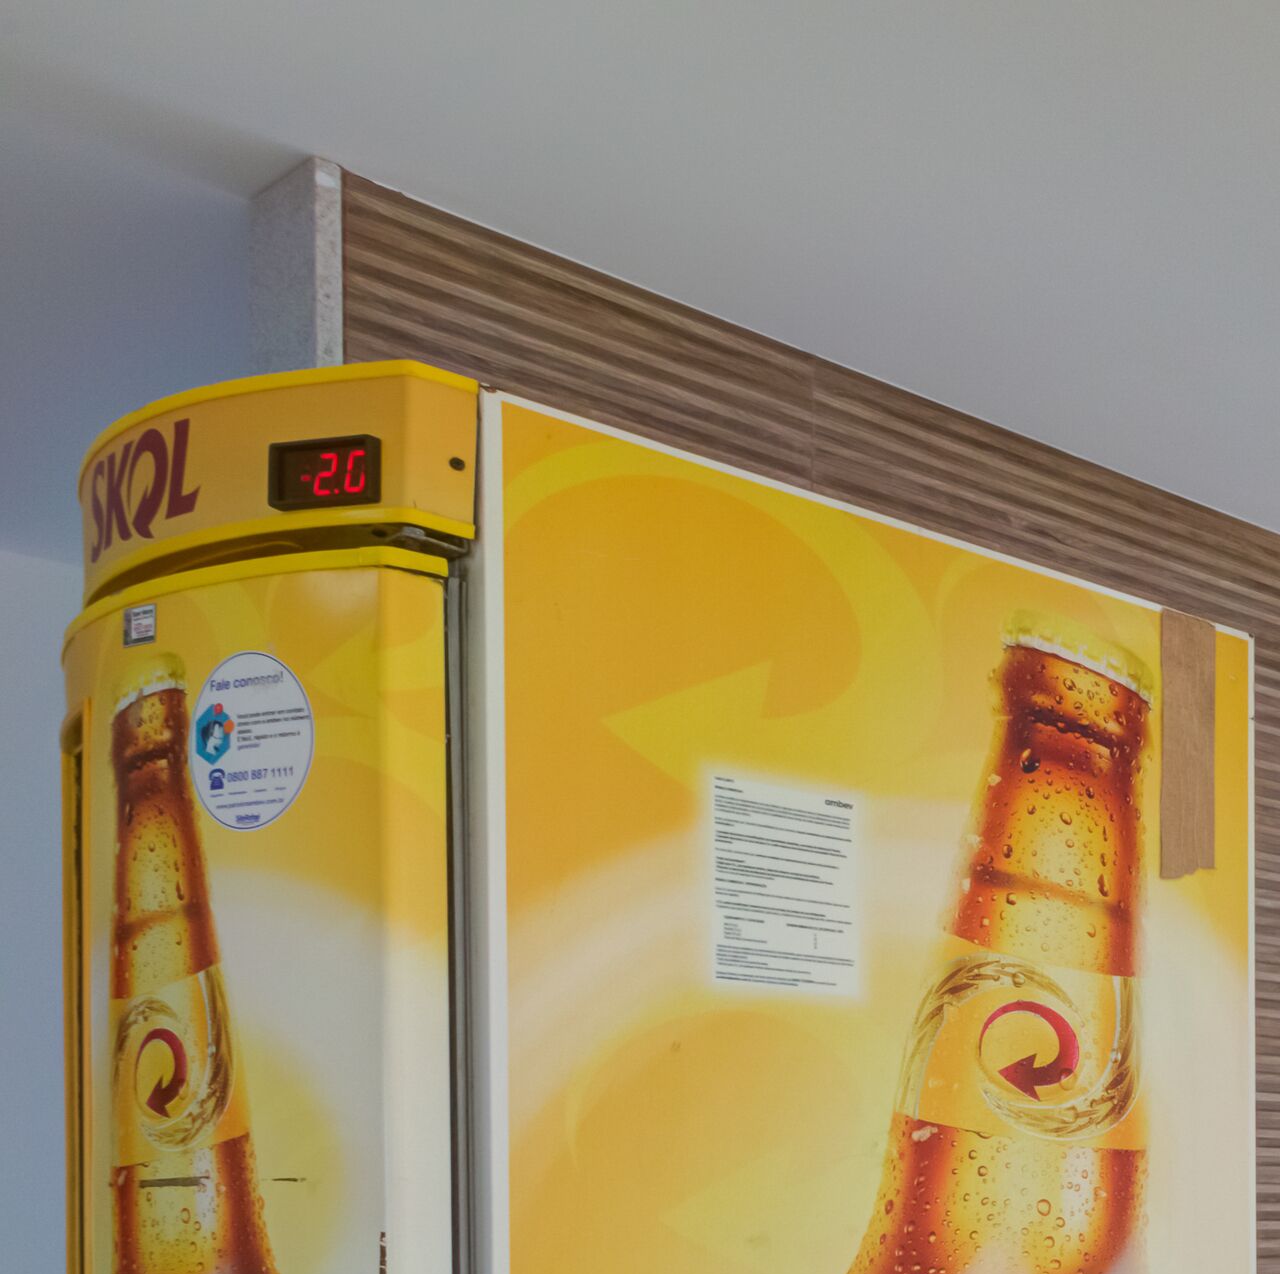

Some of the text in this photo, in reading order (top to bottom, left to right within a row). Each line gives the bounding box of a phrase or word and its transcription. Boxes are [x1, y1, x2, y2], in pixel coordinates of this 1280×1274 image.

[91, 418, 200, 564] SKOL
[210, 679, 231, 691] Fale
[271, 766, 294, 777] 1111
